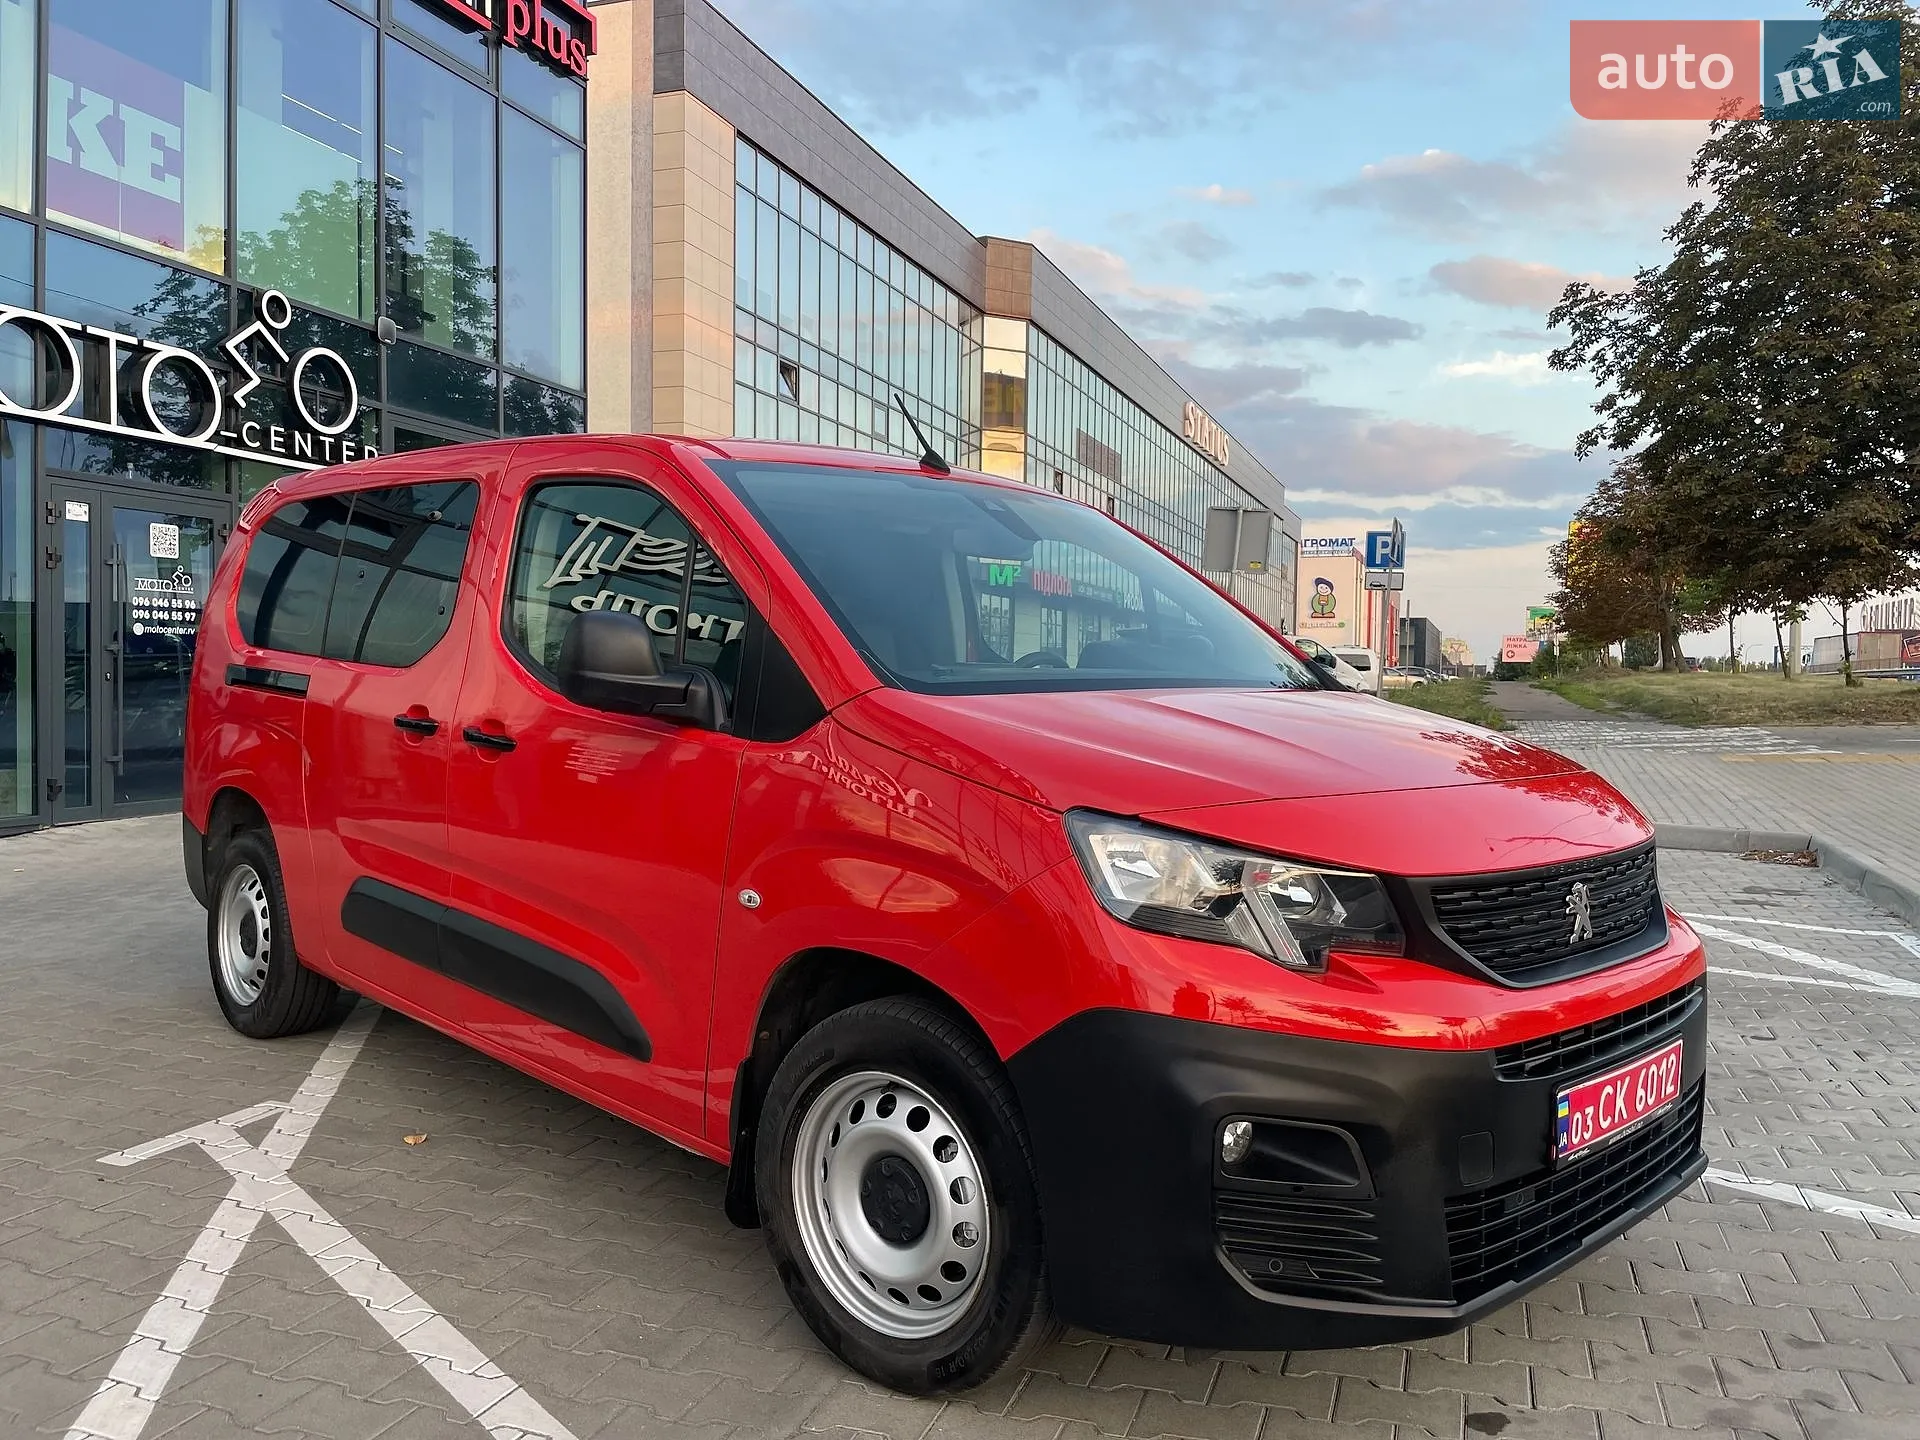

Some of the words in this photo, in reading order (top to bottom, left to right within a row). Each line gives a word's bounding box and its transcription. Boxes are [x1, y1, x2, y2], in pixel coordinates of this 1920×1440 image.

[504, 0, 587, 76] plus
[47, 73, 182, 204] KE
[1184, 401, 1230, 467] STATUS
[1300, 537, 1356, 548] ГРОМАТ
[1376, 535, 1396, 564] P
[138, 579, 173, 591] MOTO
[132, 597, 150, 607] 096
[152, 597, 169, 608] 046
[171, 598, 183, 609] 55
[184, 599, 196, 610] 96
[132, 609, 150, 619] 096
[152, 610, 169, 620] 046
[171, 611, 183, 621] 55
[184, 611, 196, 622] 97
[144, 625, 196, 635] motocenter.rv
[1571, 1105, 1594, 1145] 03
[1598, 1075, 1631, 1130] CK
[1635, 1053, 1677, 1112] 6012
